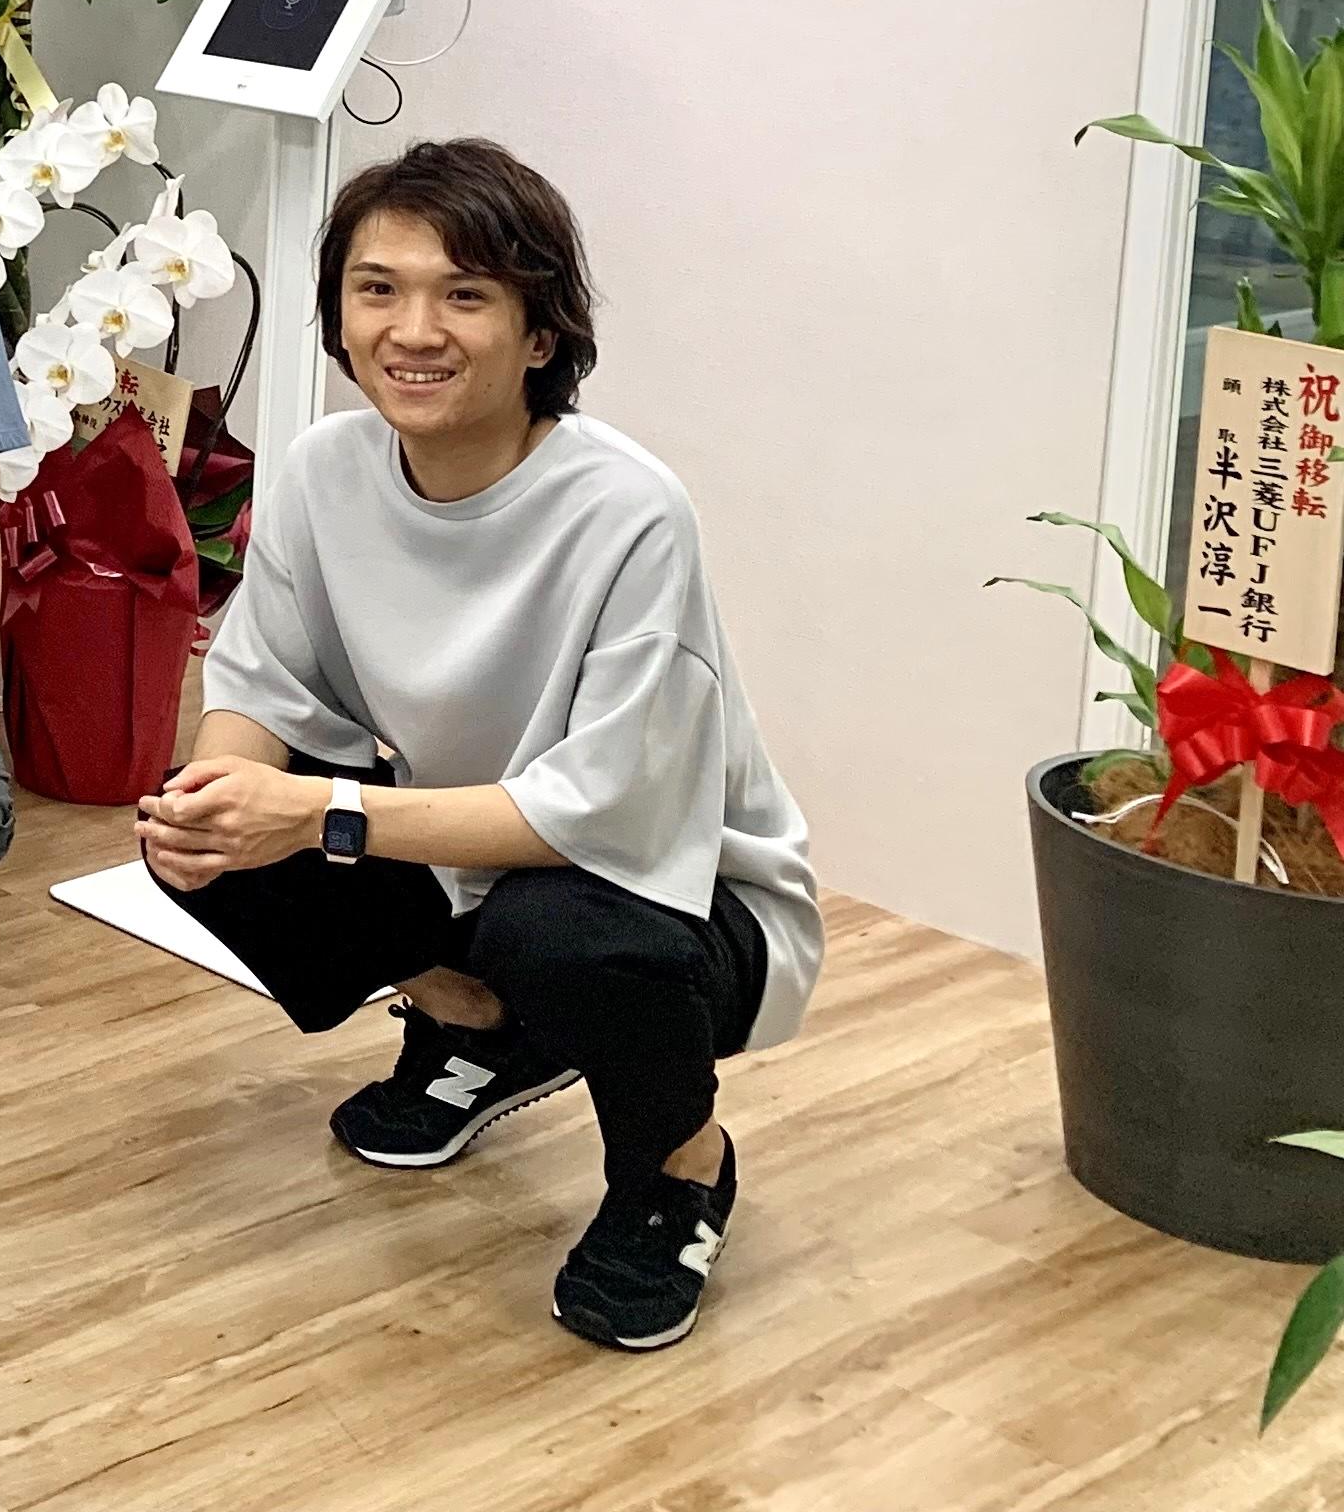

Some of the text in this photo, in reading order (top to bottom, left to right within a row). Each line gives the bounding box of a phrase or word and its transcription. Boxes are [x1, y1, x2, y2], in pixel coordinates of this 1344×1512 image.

[114, 367, 139, 397] 転
[1290, 363, 1340, 520] 祝御移転
